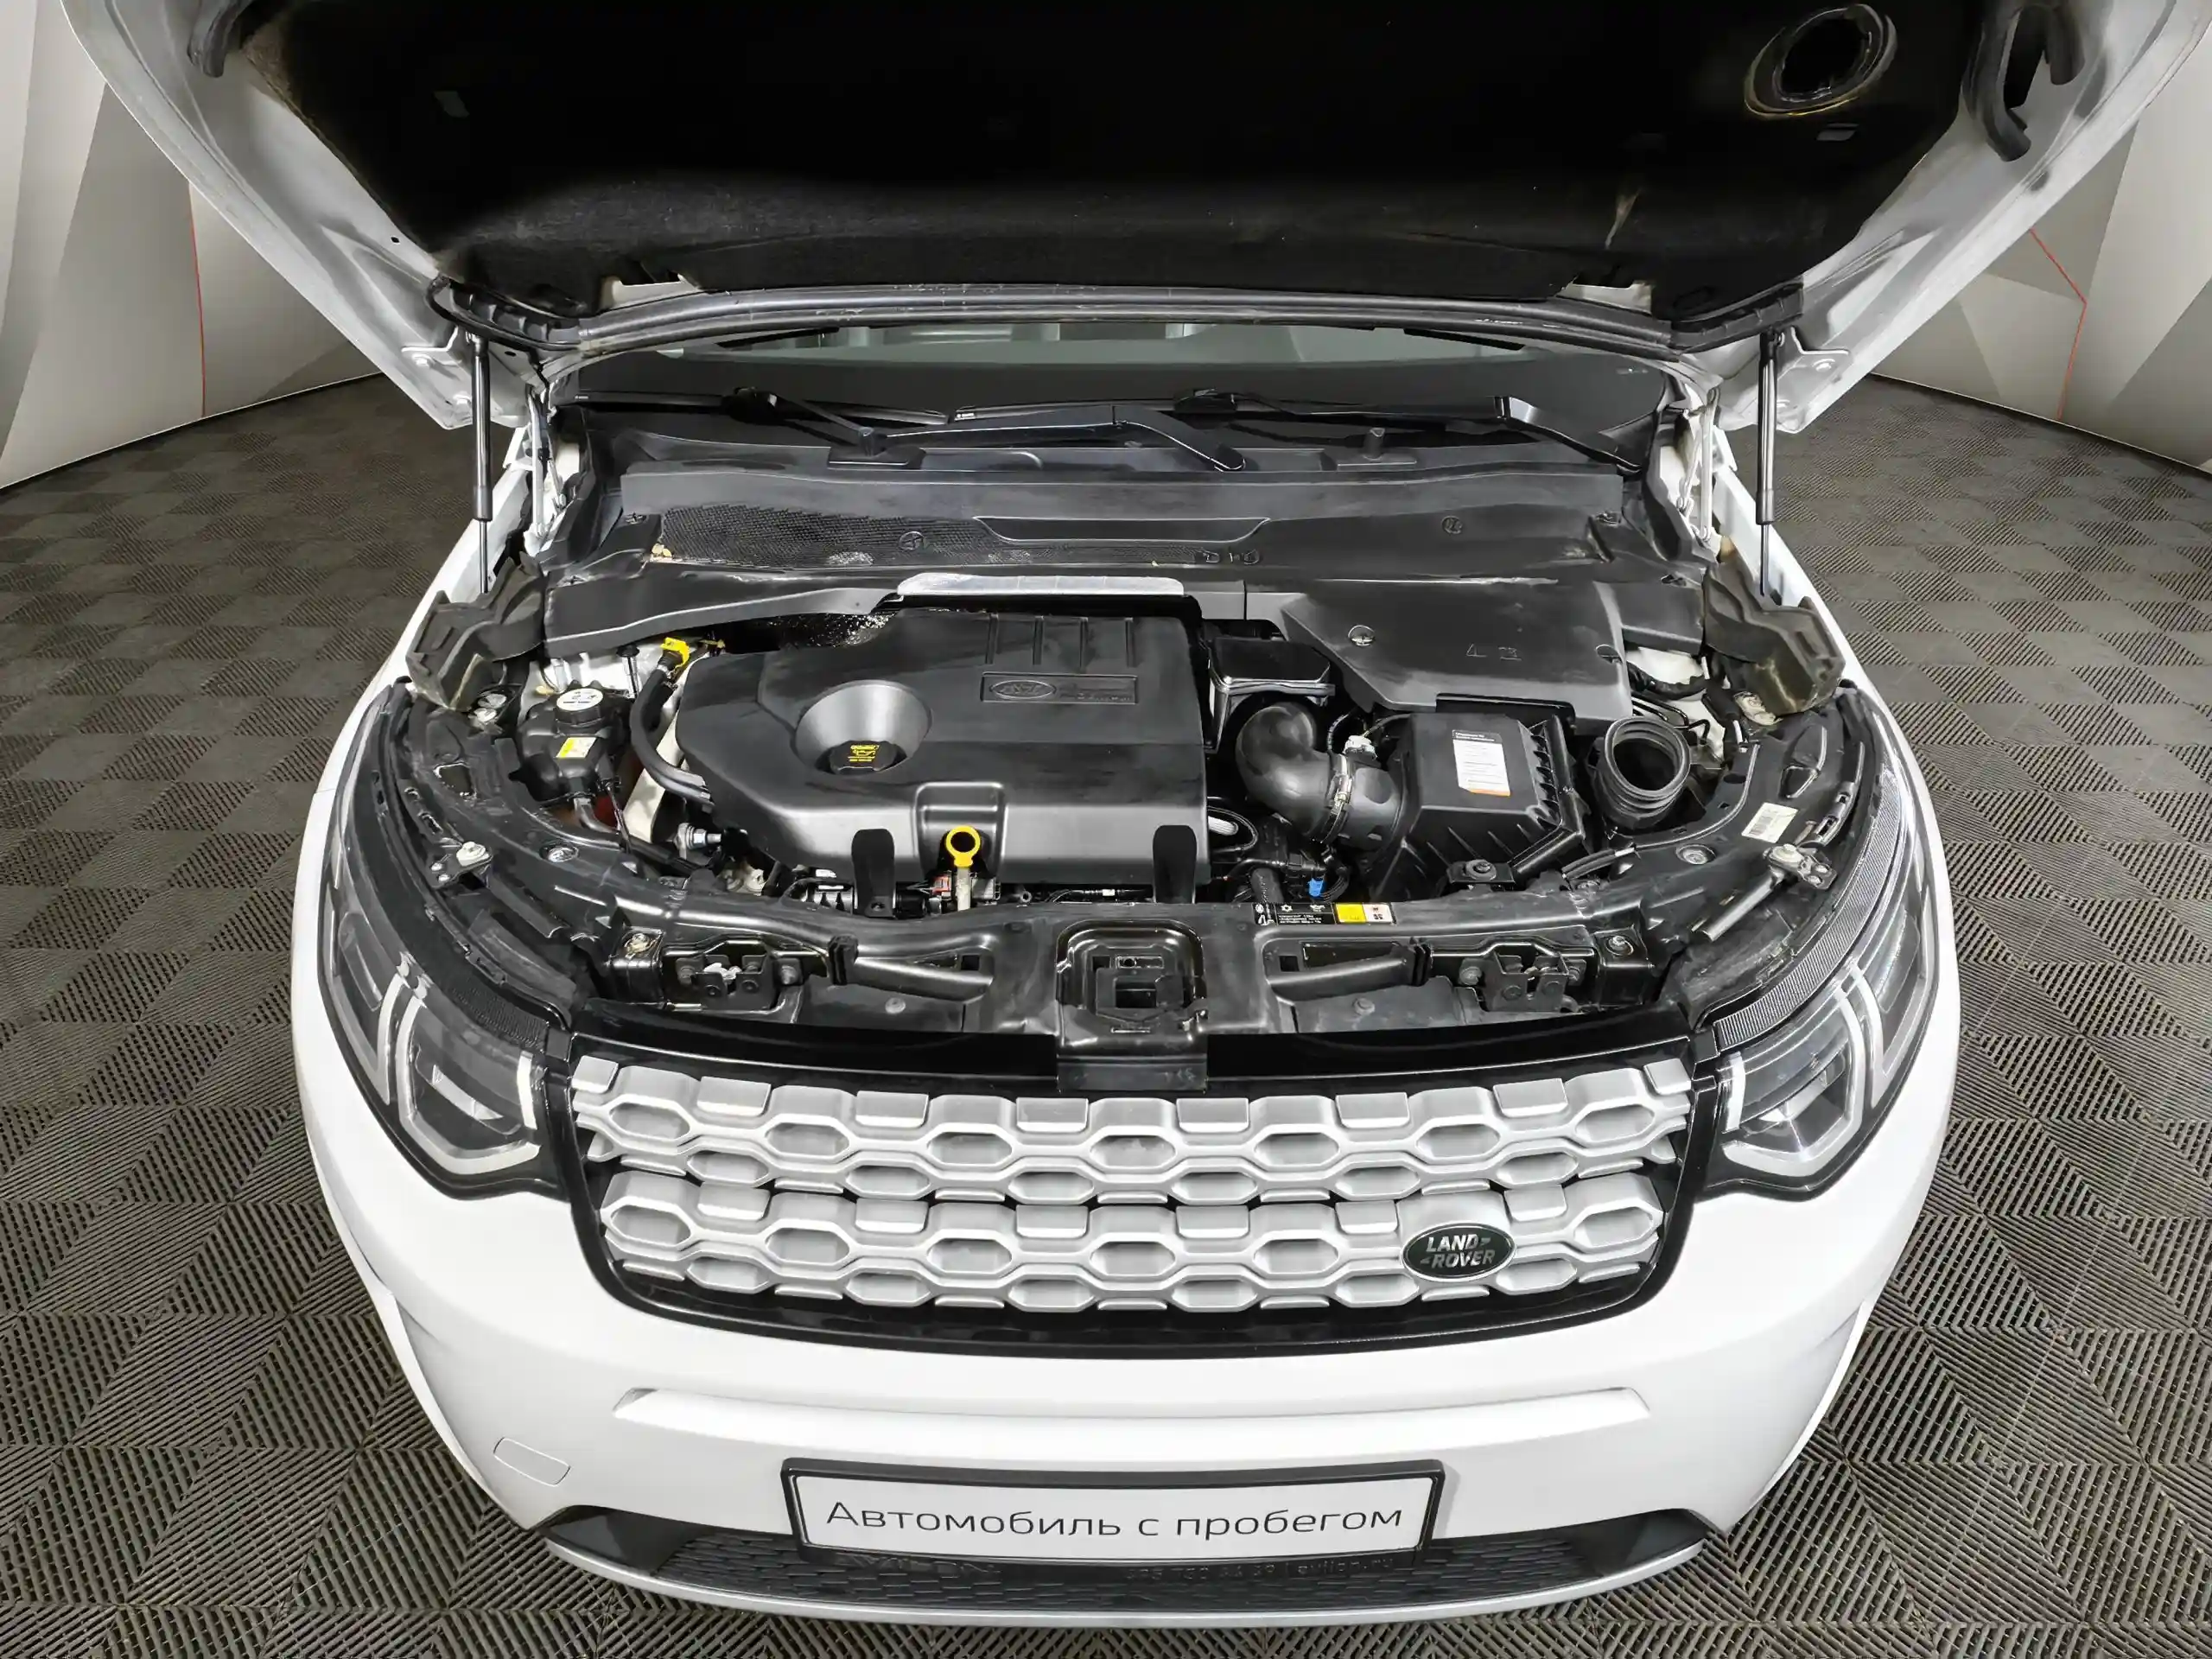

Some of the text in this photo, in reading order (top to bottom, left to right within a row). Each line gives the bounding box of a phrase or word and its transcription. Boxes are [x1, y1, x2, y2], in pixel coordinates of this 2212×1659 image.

[1426, 1234, 1479, 1252] LAND
[1431, 1249, 1496, 1268] ROVER
[826, 1502, 1402, 1541] Автомобиль с пробегом
